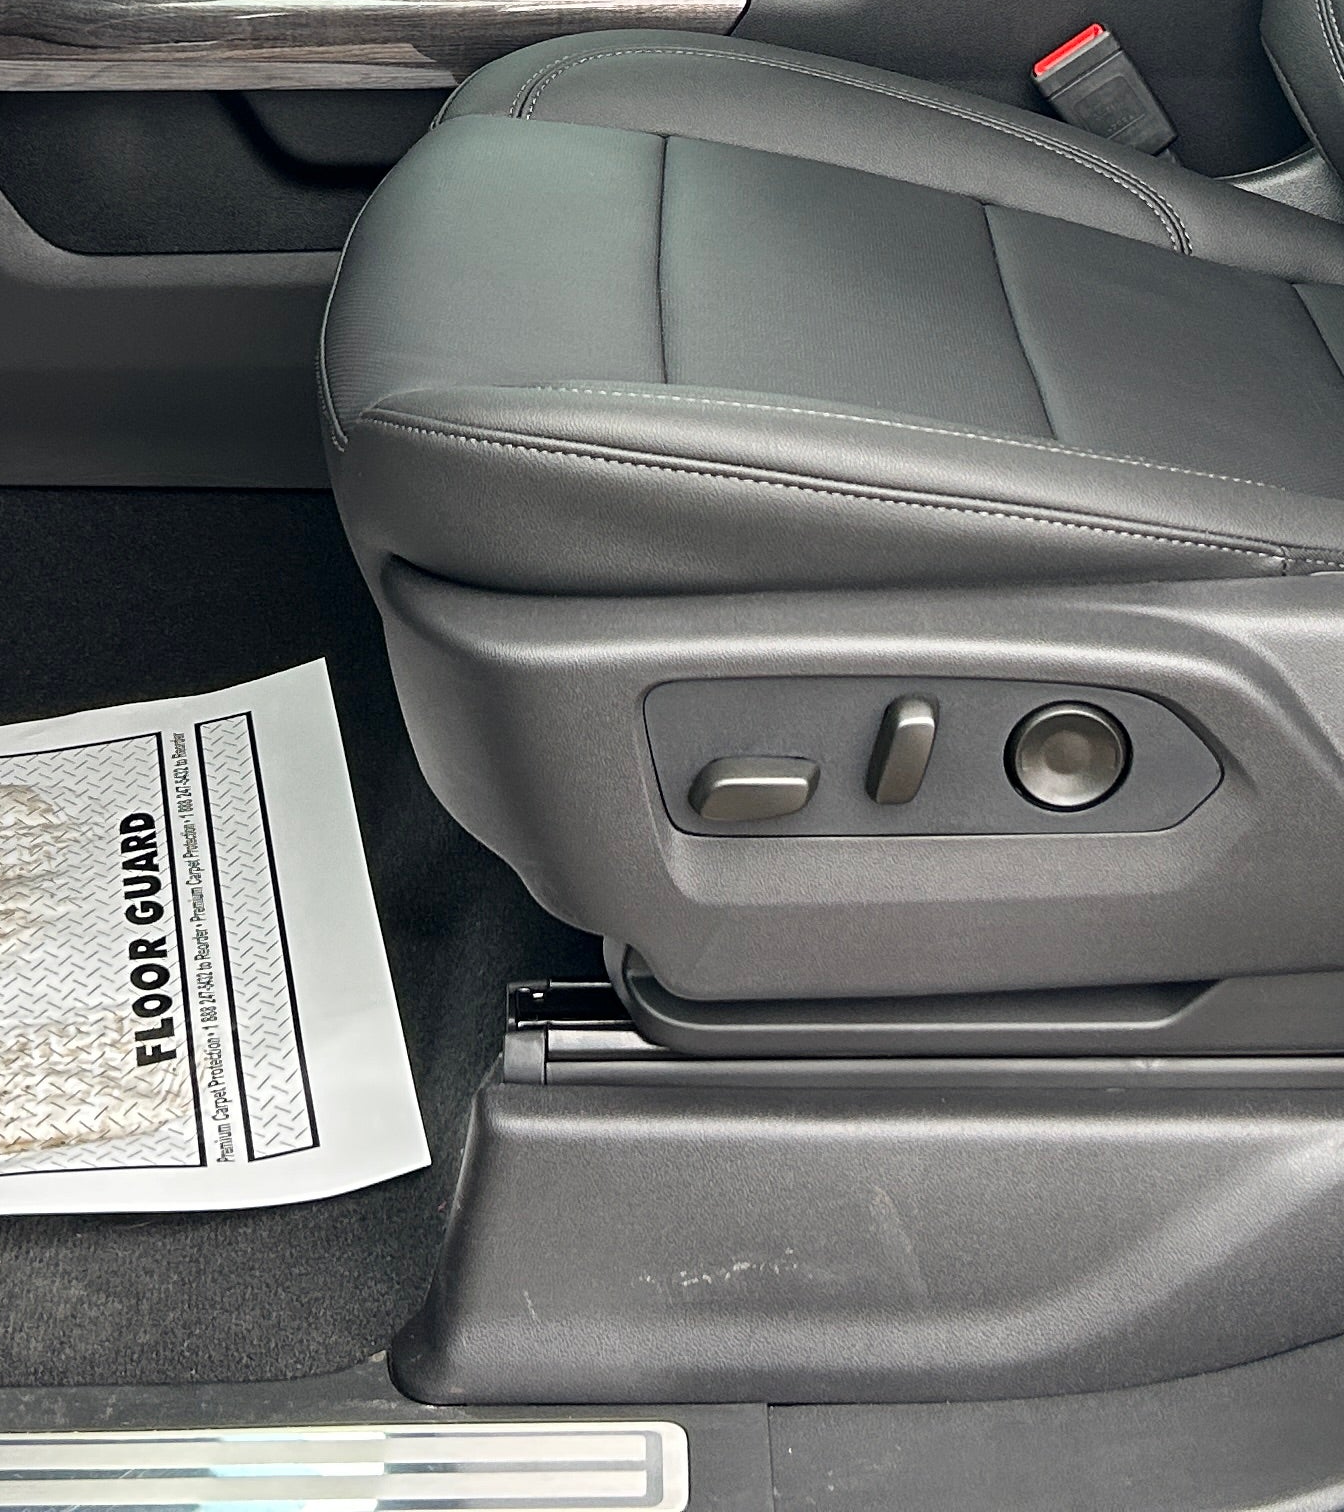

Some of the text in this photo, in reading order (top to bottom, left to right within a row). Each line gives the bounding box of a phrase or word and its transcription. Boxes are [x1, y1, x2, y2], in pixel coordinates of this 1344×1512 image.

[119, 812, 177, 1067] FLOOR GUARD
[193, 929, 211, 960] Reorder
[207, 1037, 223, 1088] Protection
[211, 1088, 234, 1122] Carpet
[215, 1122, 236, 1163] Premium
